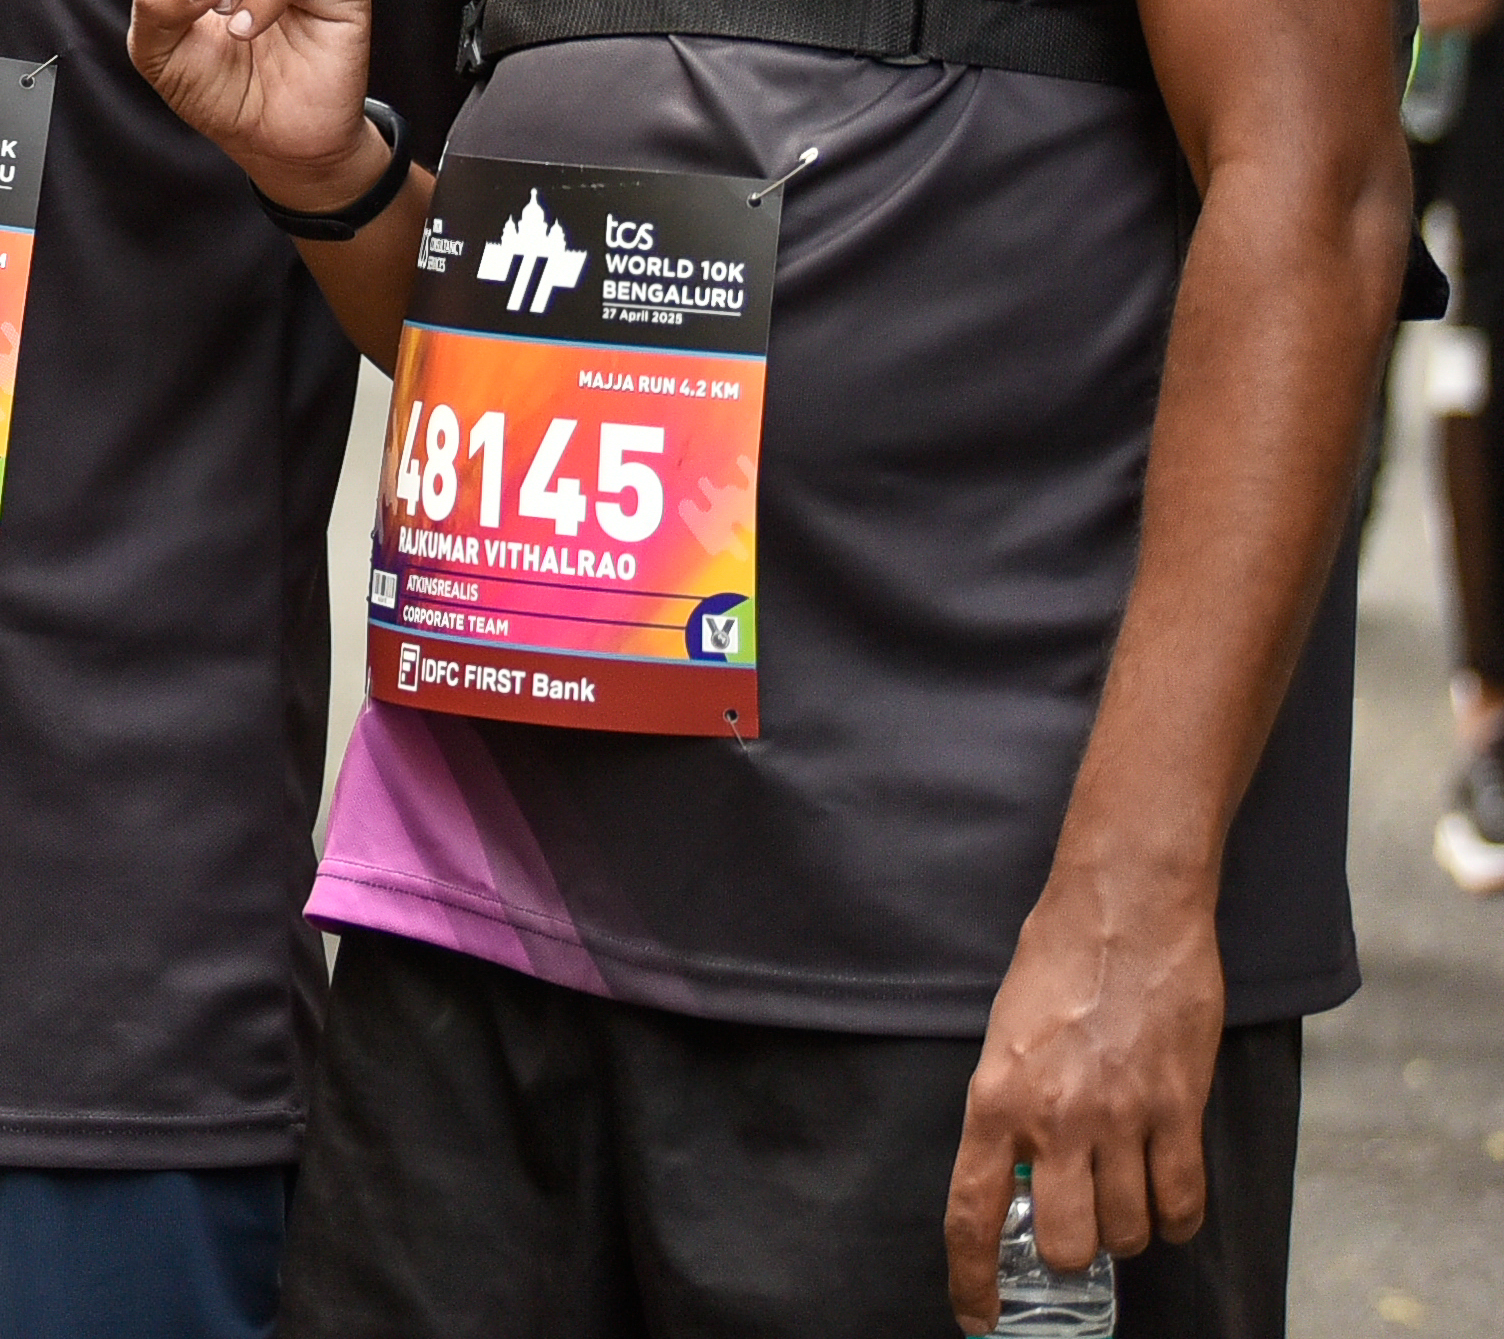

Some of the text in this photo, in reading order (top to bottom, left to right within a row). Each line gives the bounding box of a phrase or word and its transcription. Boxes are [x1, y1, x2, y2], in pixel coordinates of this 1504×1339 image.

[605, 214, 654, 249] tcs
[604, 253, 745, 283] WORLD 10K
[602, 280, 744, 310] BENGALURU
[602, 307, 683, 326] 27 April 2025
[578, 370, 741, 400] MAJJA RUN 4.2 KM
[396, 400, 665, 544] 48145
[398, 525, 637, 581] RAJKUMAR VITHALRAO
[405, 573, 480, 602] ATKINSREALIS
[402, 605, 509, 636] CORPORATE TEAM
[421, 658, 596, 703] IDFC FIRST Bank
